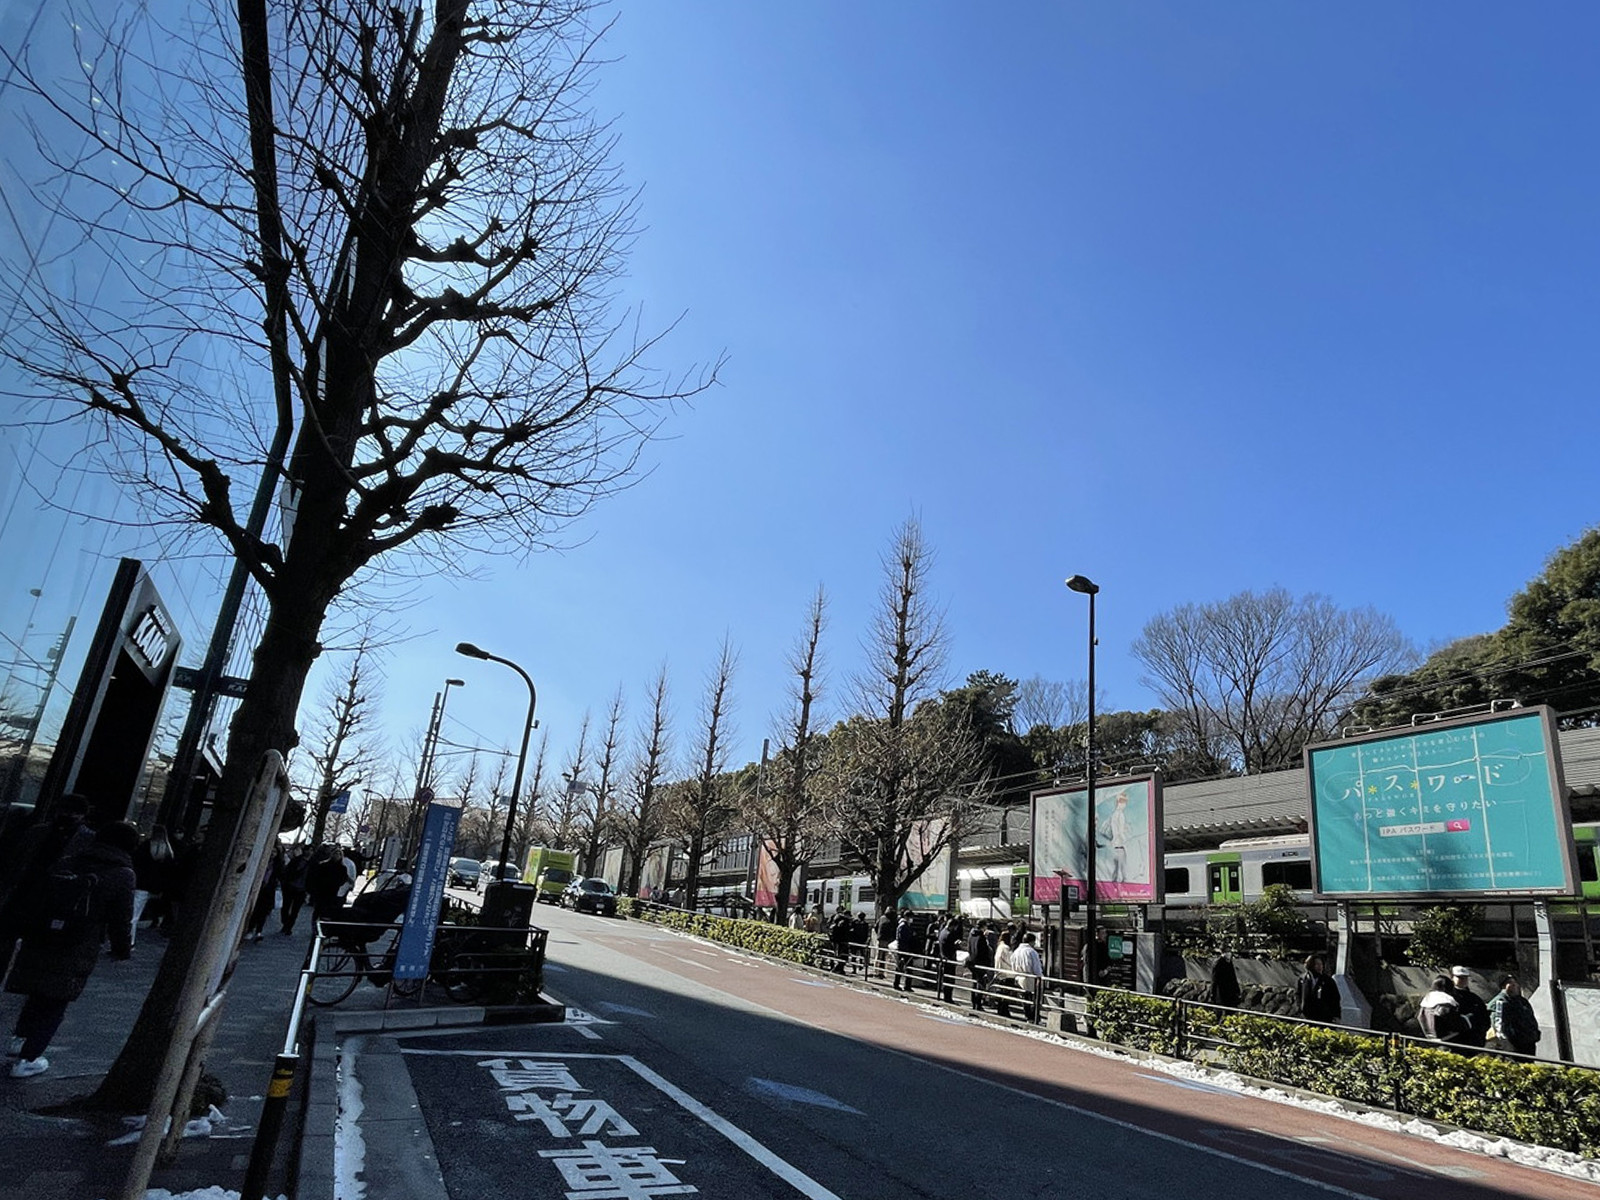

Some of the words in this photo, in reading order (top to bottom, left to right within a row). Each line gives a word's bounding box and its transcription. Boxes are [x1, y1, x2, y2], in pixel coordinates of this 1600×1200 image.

[1382, 827, 1397, 835] IPA
[1400, 825, 1436, 834] パスワード
